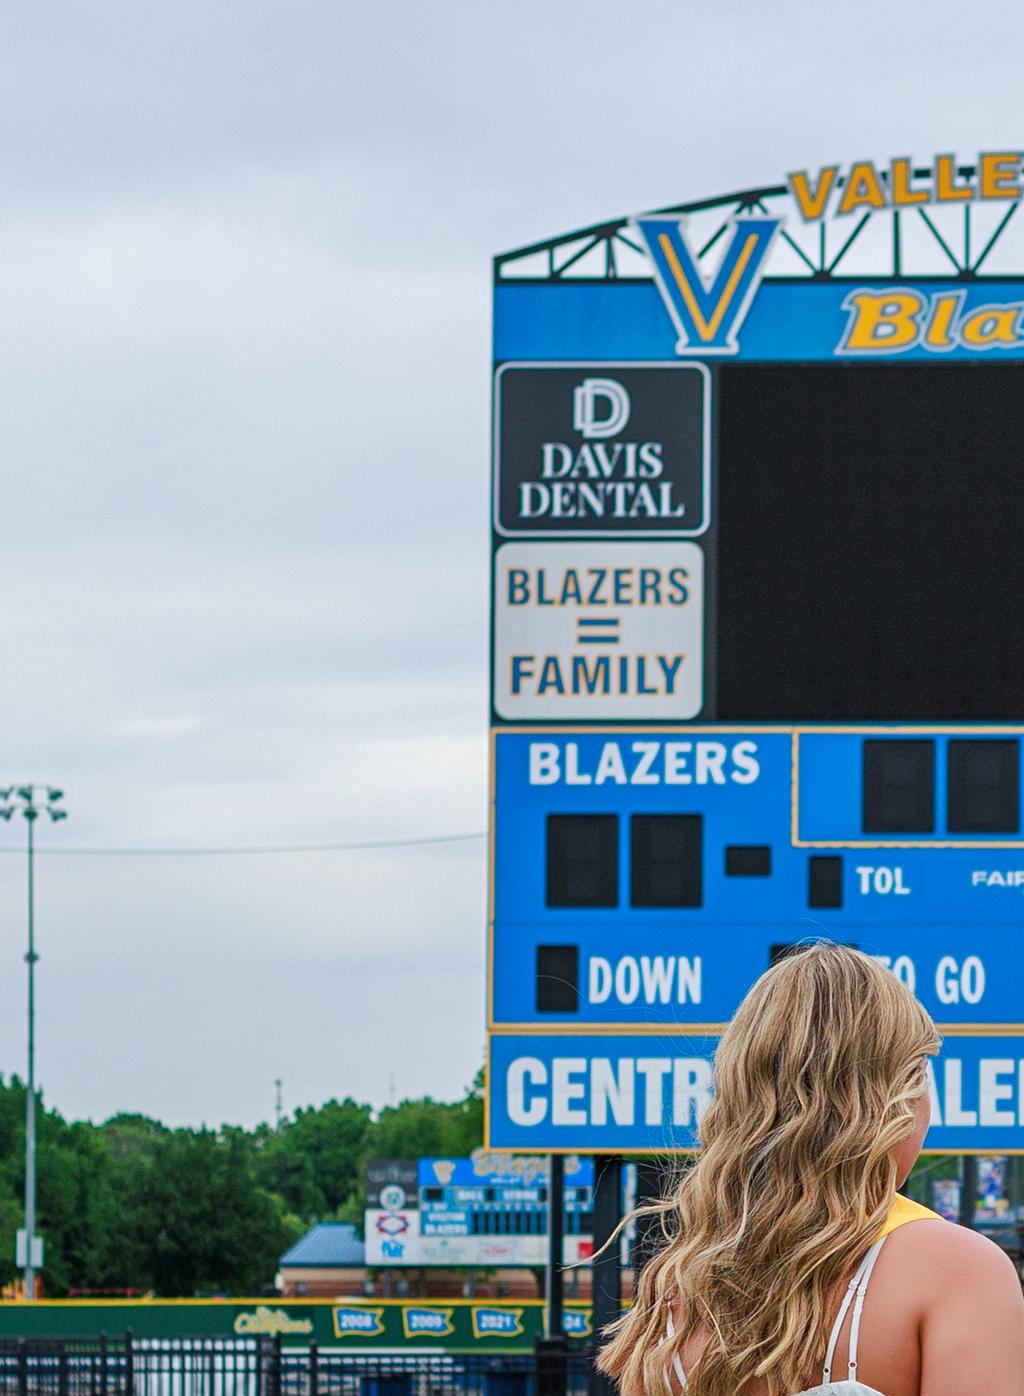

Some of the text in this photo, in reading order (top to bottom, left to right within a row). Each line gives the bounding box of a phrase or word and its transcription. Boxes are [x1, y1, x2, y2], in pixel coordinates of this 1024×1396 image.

[632, 212, 783, 357] V
[542, 443, 664, 479] DAVIS
[519, 482, 686, 518] DENTAL
[506, 567, 690, 607] BLAZERS
[510, 655, 685, 697] FAMILY
[529, 741, 760, 786] BLAZERS
[855, 866, 911, 896] TOL
[588, 956, 702, 1005] DOWN
[868, 955, 986, 1005] O GO
[506, 1057, 715, 1127] CENTR
